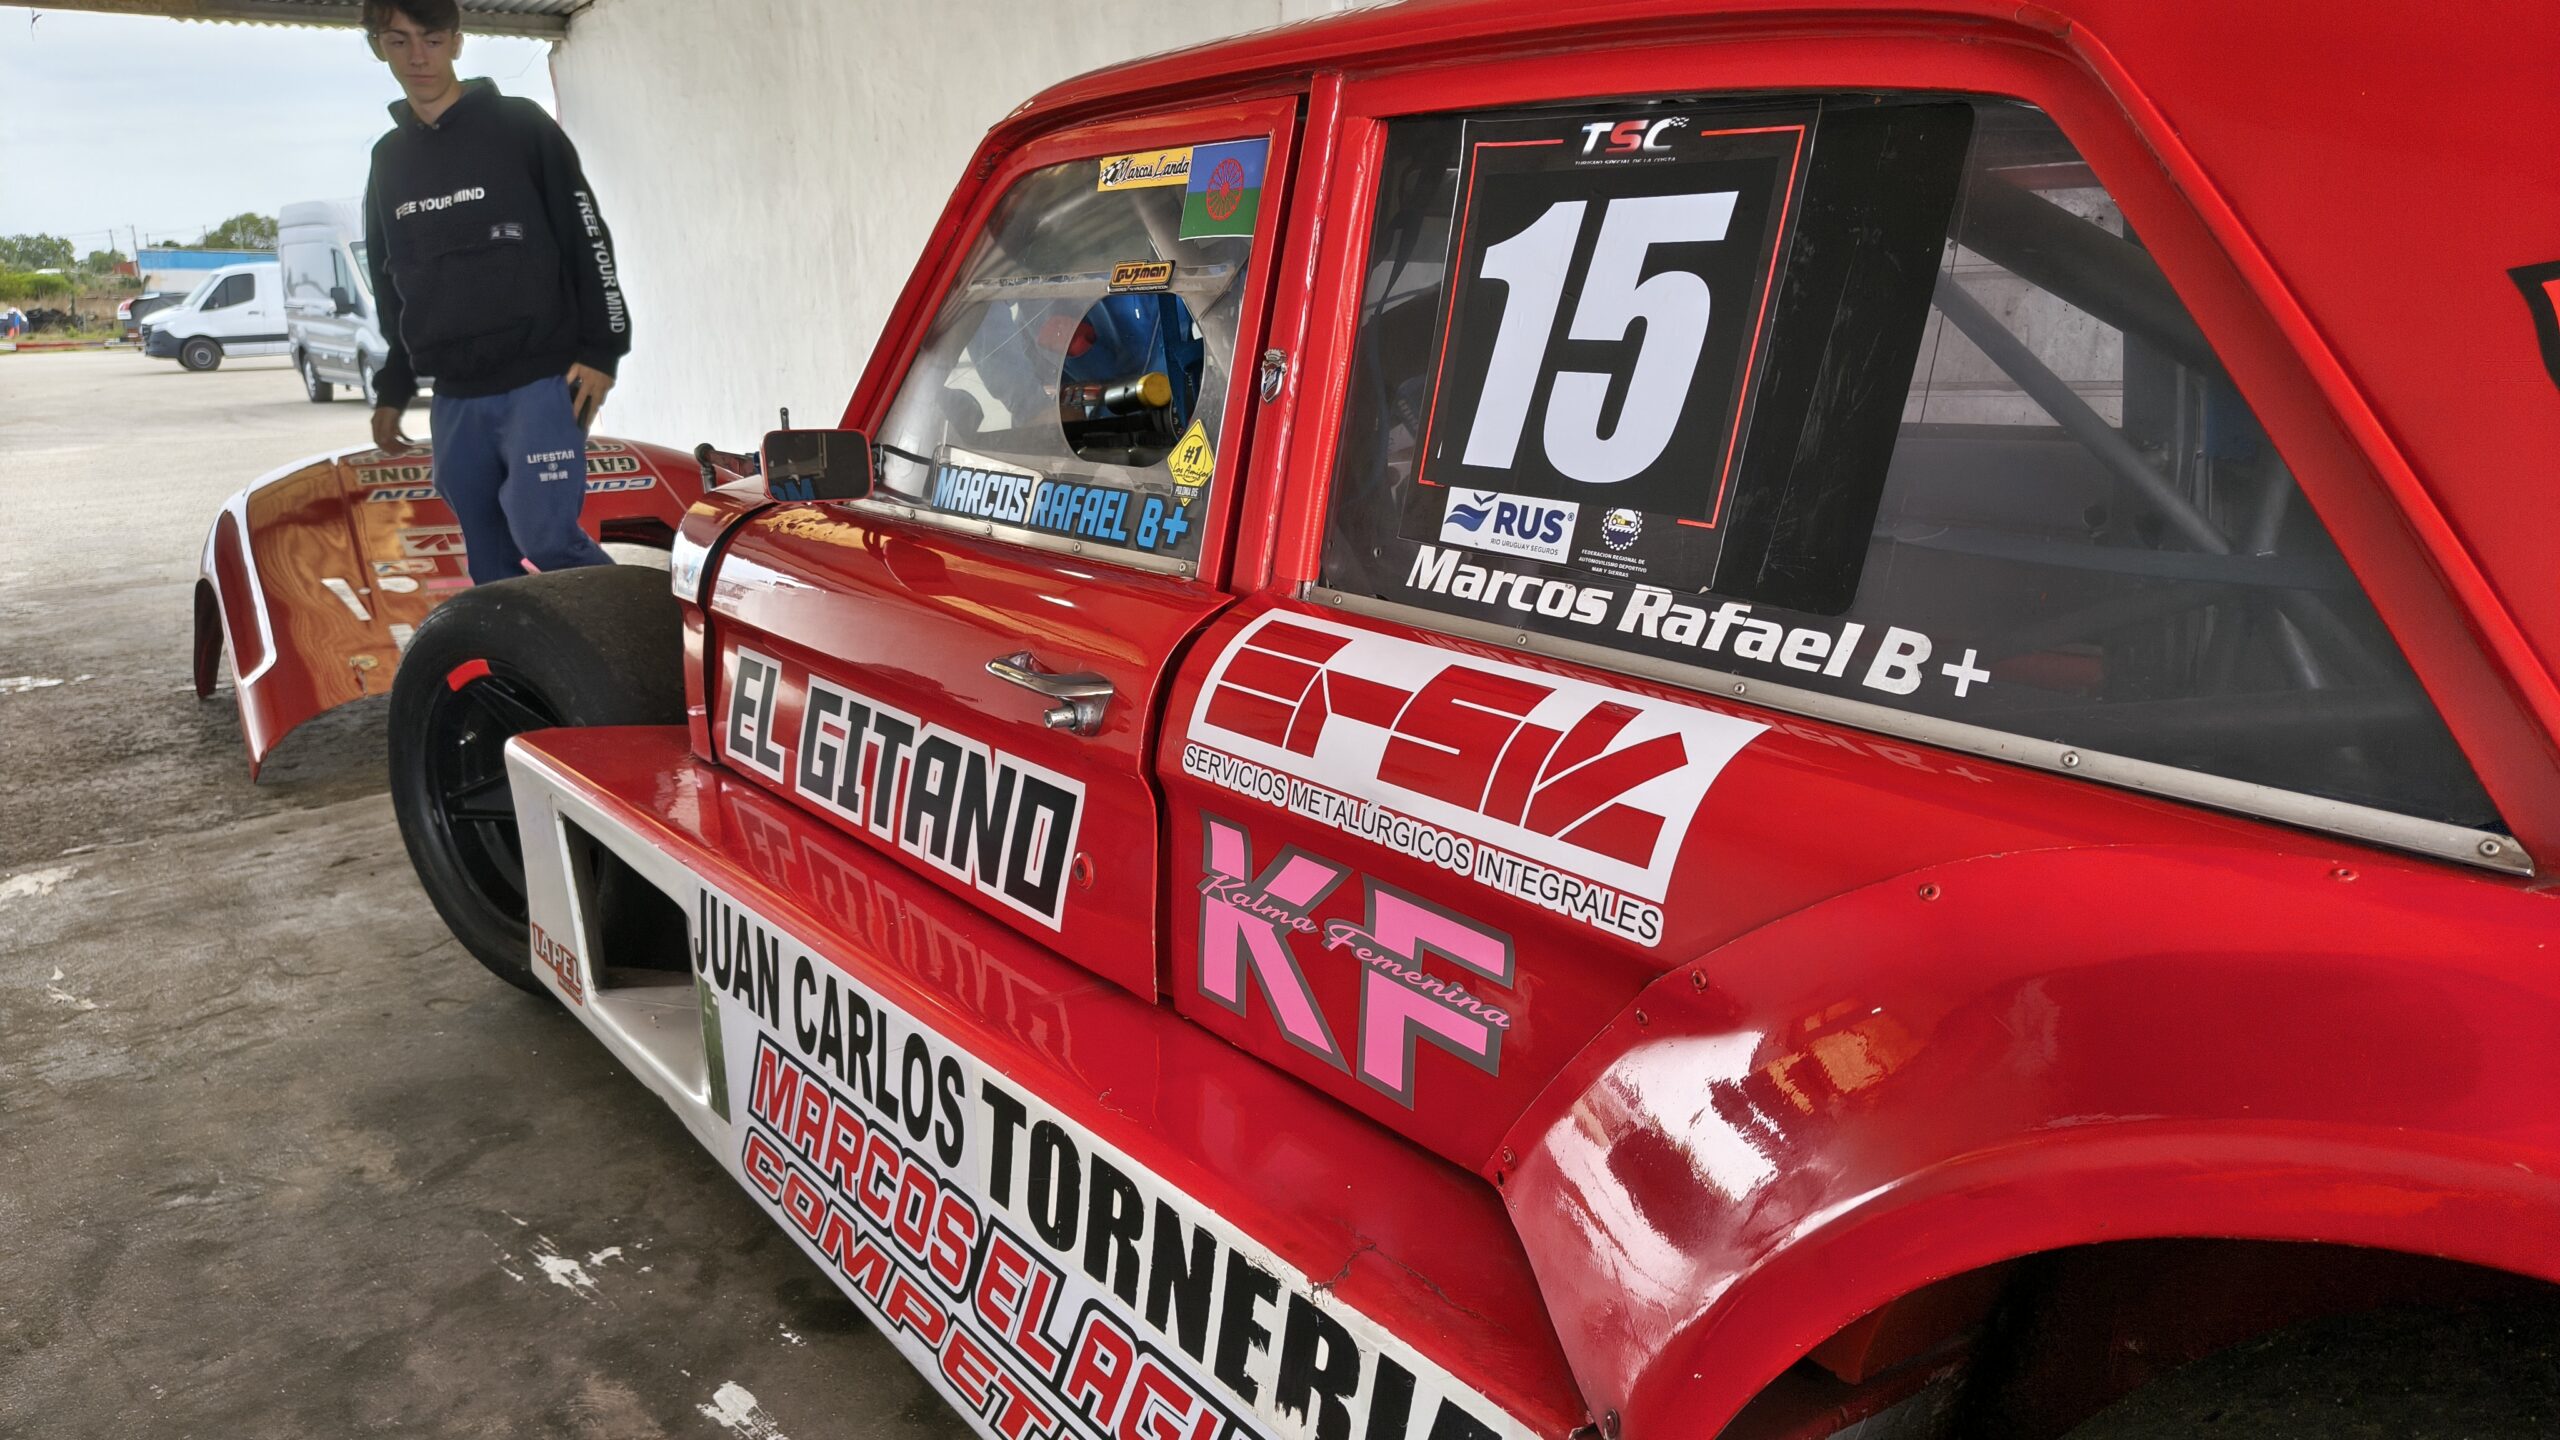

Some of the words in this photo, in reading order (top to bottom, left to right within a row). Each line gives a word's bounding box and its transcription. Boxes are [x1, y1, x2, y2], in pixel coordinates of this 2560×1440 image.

[1114, 158, 1153, 184] Marcos
[1153, 154, 1190, 178] Landa
[1582, 118, 1675, 155] TSC
[418, 195, 453, 213] YOUR
[453, 187, 486, 204] MIND
[574, 191, 600, 237] FREE
[592, 240, 617, 289] YOUR
[605, 291, 626, 334] MIND
[1462, 190, 1740, 483] 15
[526, 448, 576, 464] LIFESTAR
[1183, 445, 1204, 466] #1
[932, 466, 1031, 522] MARCOS
[1030, 480, 1129, 542] RAFAEL
[1493, 501, 1566, 544] RUS
[1501, 540, 1530, 550] URUGUAY
[1530, 545, 1559, 556] SEGUROS
[1578, 556, 1619, 568] AUTOMOVILISMO
[1618, 563, 1647, 574] DEPORTIVO
[1612, 554, 1637, 564] REGIONAL
[1406, 545, 1614, 624] Marcos
[1617, 583, 1865, 678] Rafael
[730, 656, 782, 773] EL
[800, 685, 1078, 920] GITANO
[1184, 745, 1286, 801] SERVICIOS
[1290, 784, 1470, 870] METALÚRGICOS
[1477, 851, 1660, 941] INTEGRALES
[1202, 875, 1318, 932] Kalma
[1327, 924, 1511, 1029] Femenina
[1203, 820, 1505, 1092] KF
[694, 888, 780, 1031] JUAN
[794, 955, 966, 1168] CARLOS
[753, 1045, 976, 1288] MARCOS
[975, 1233, 1056, 1374] EL
